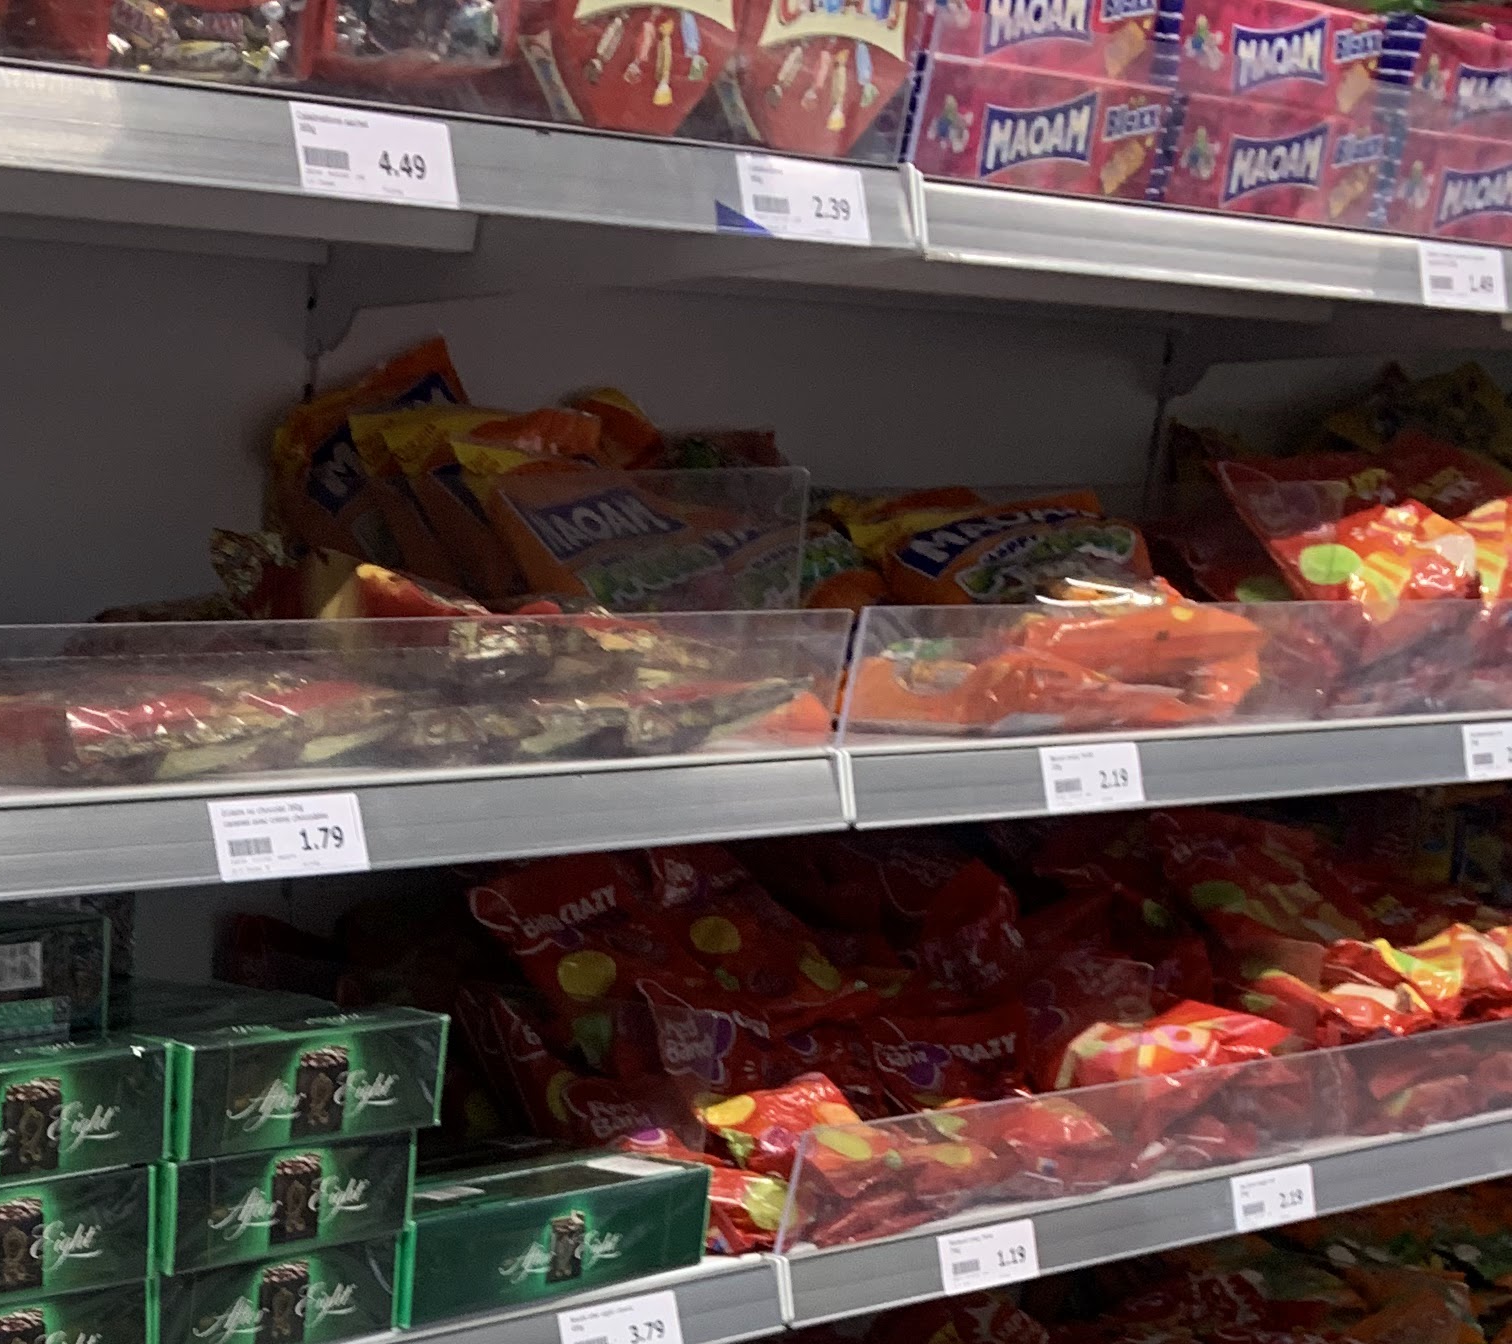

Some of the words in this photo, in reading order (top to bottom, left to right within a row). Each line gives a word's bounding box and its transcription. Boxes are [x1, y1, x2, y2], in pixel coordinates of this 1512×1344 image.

[1238, 28, 1323, 87] MAOAM
[985, 105, 1092, 170] MAOAM
[378, 150, 426, 180] 4.49
[1228, 133, 1325, 195] MAOAM
[812, 195, 850, 221] 2.39
[299, 826, 345, 851] 1.79
